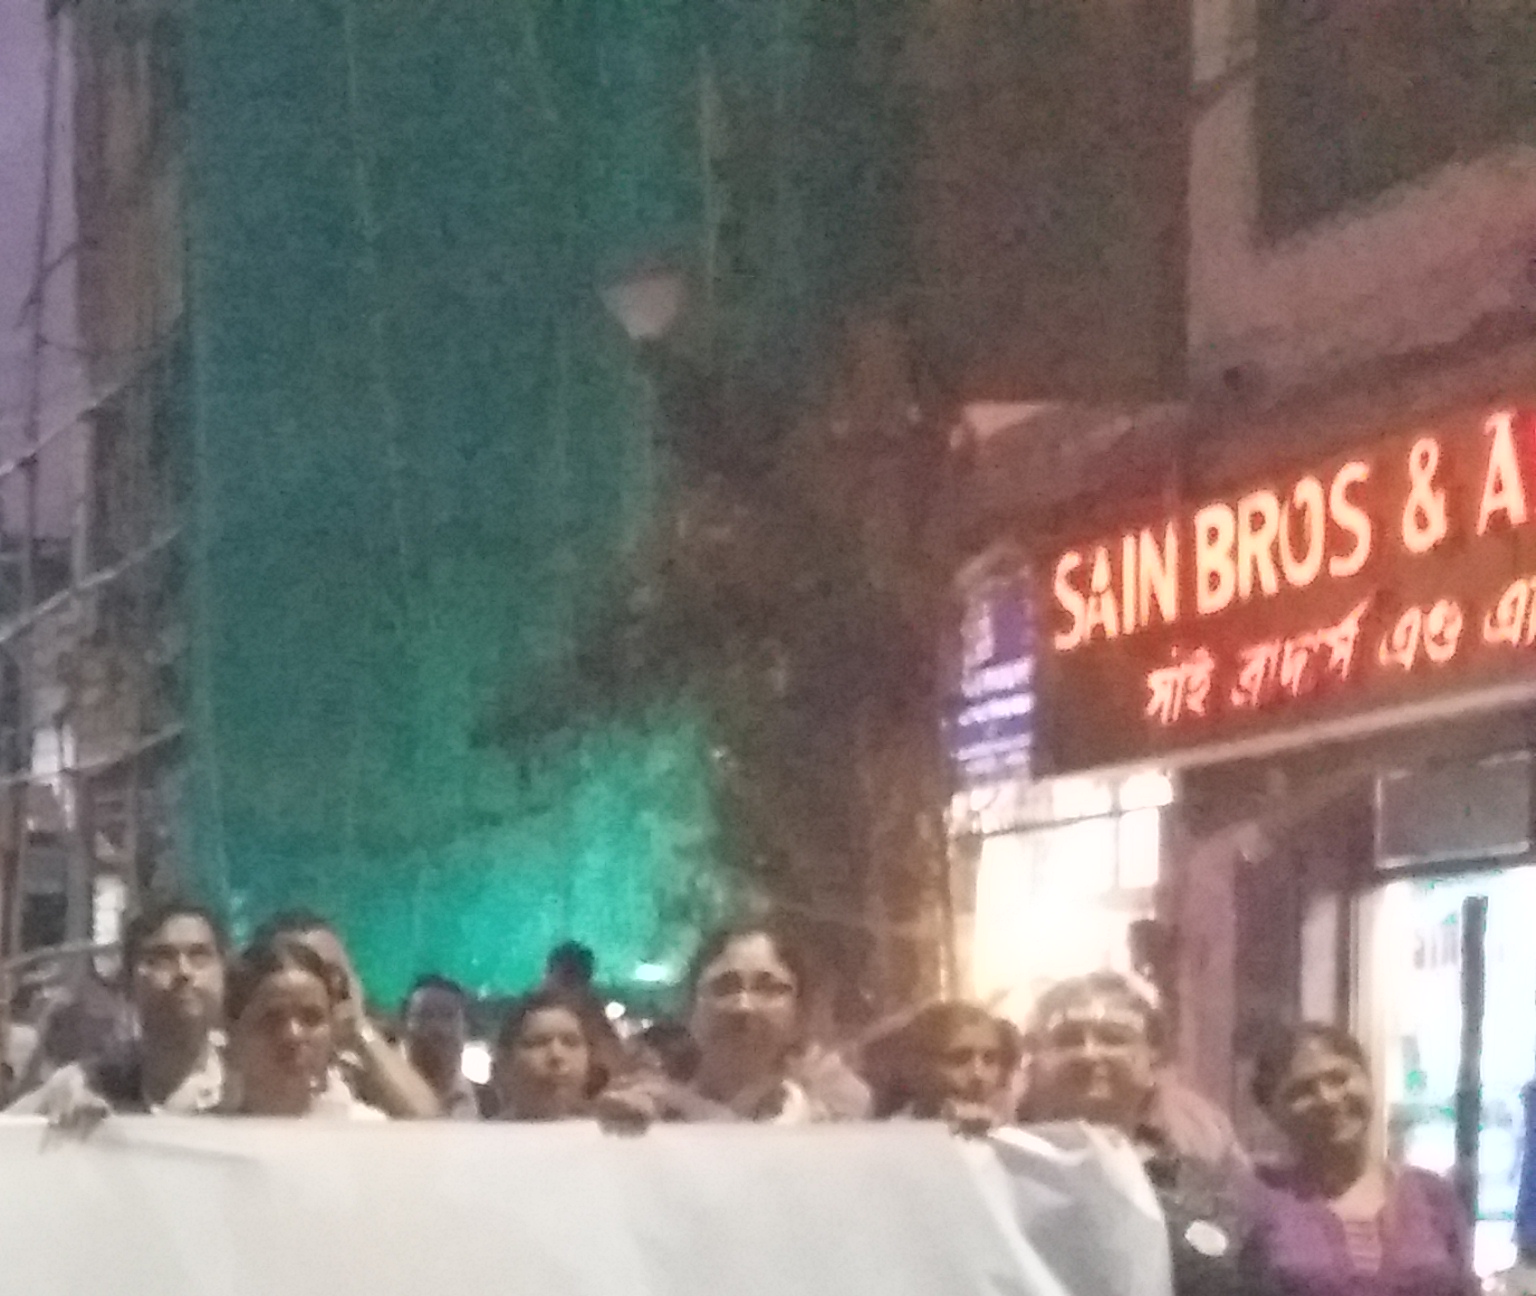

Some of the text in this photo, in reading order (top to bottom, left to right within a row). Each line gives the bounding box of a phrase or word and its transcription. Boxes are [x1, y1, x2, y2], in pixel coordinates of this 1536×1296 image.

[1053, 520, 1179, 651] SAIN
[1194, 461, 1372, 616] BROS
[1402, 438, 1448, 553] &
